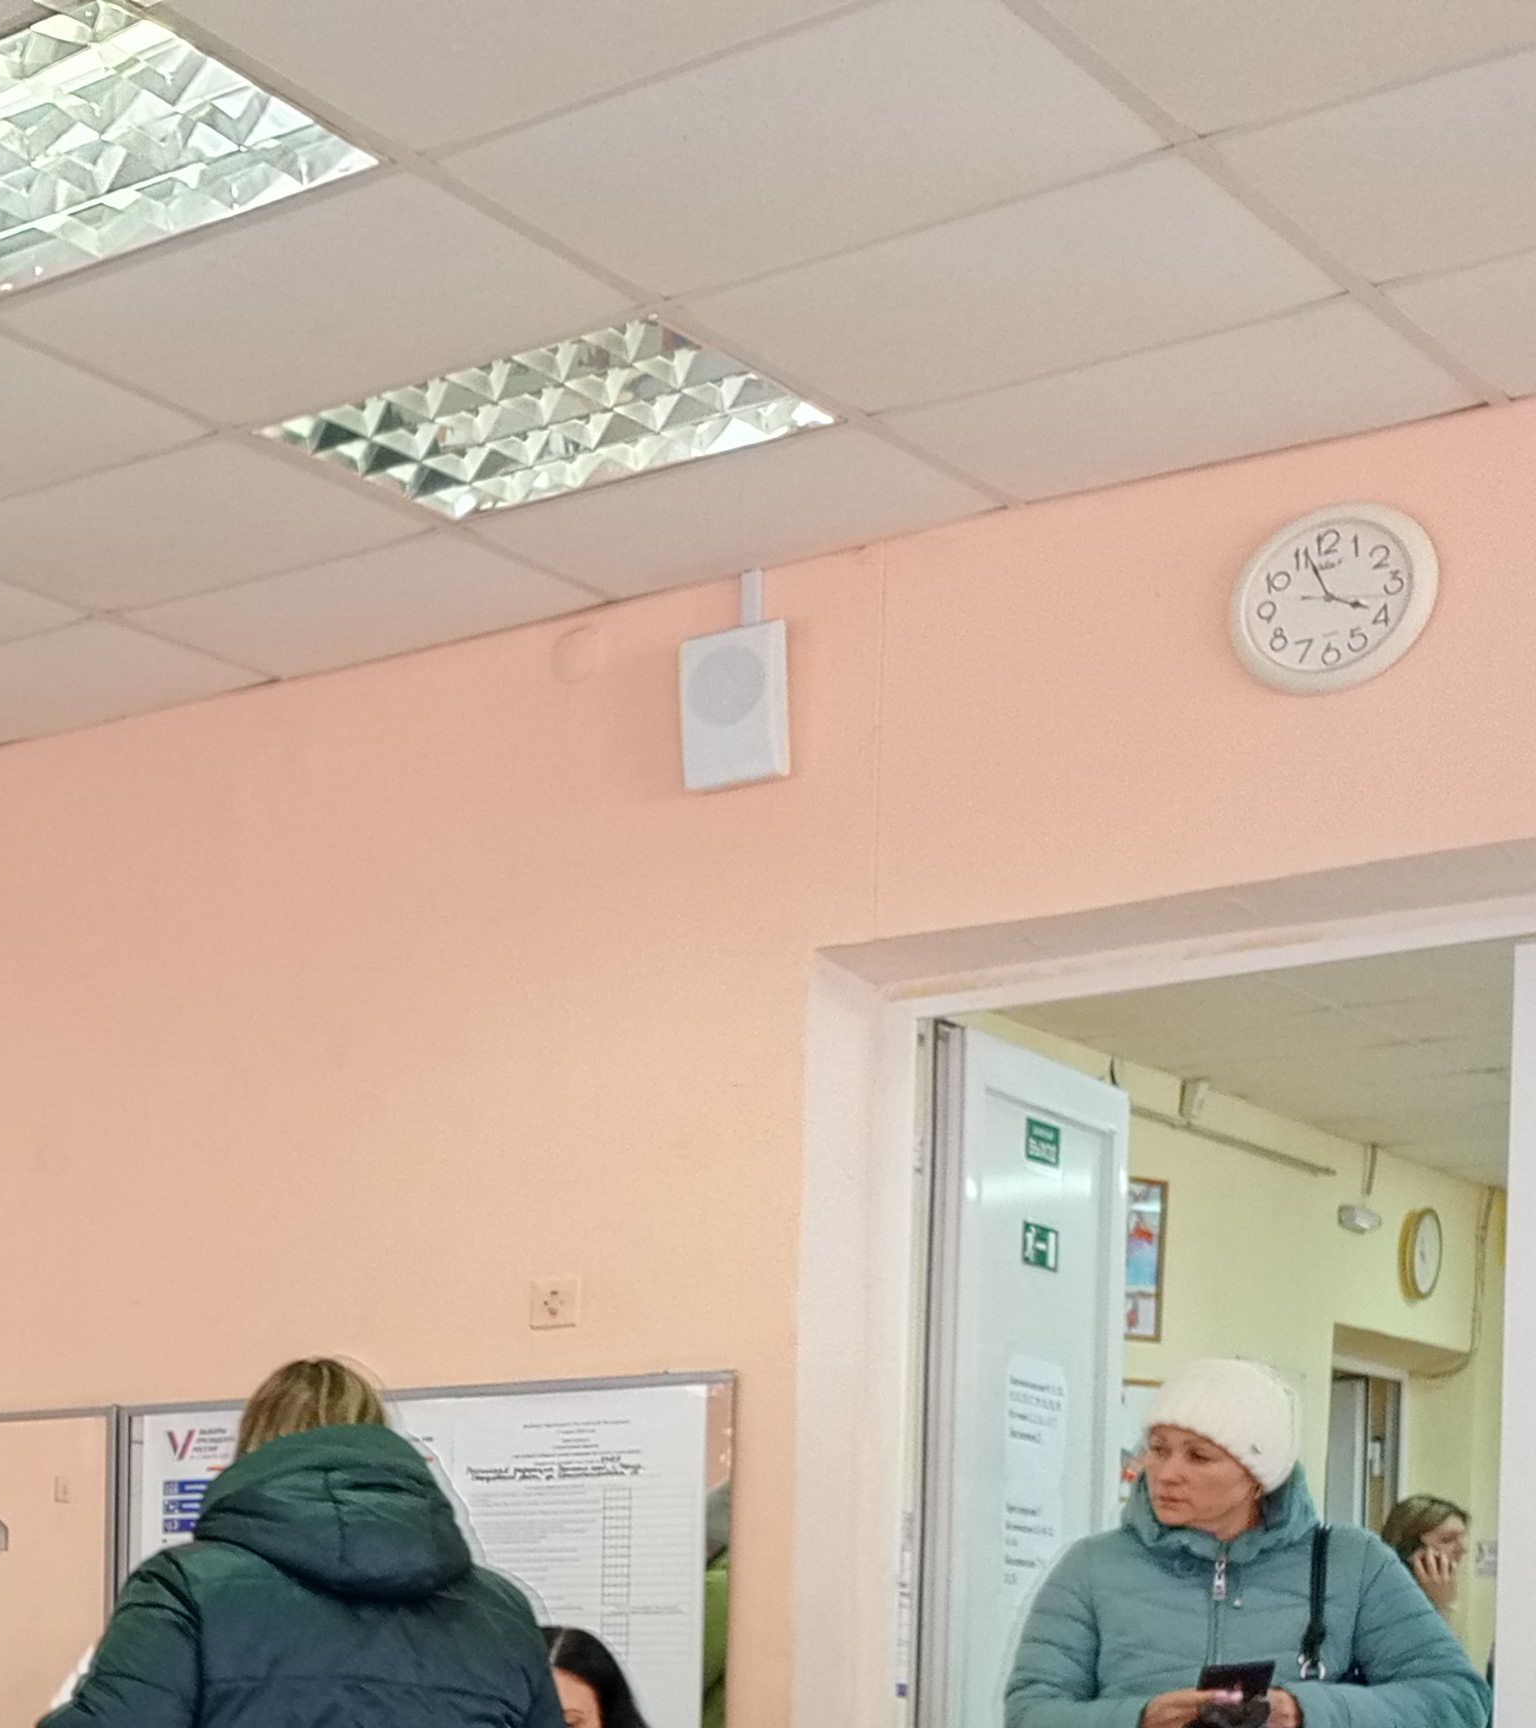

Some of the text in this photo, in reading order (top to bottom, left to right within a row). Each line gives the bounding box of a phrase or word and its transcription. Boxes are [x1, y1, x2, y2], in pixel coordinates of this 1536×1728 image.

[1316, 529, 1340, 557] 12
[1352, 534, 1359, 557] 1
[1294, 546, 1309, 571] 11
[1368, 545, 1390, 570] 2
[1266, 571, 1291, 594] 10
[1383, 570, 1405, 595] 3
[1257, 601, 1277, 624] 9
[1371, 603, 1390, 627] 4
[1269, 627, 1288, 652] 8
[1294, 638, 1314, 664] 7
[1347, 627, 1368, 652] 5
[1321, 642, 1341, 666] 6
